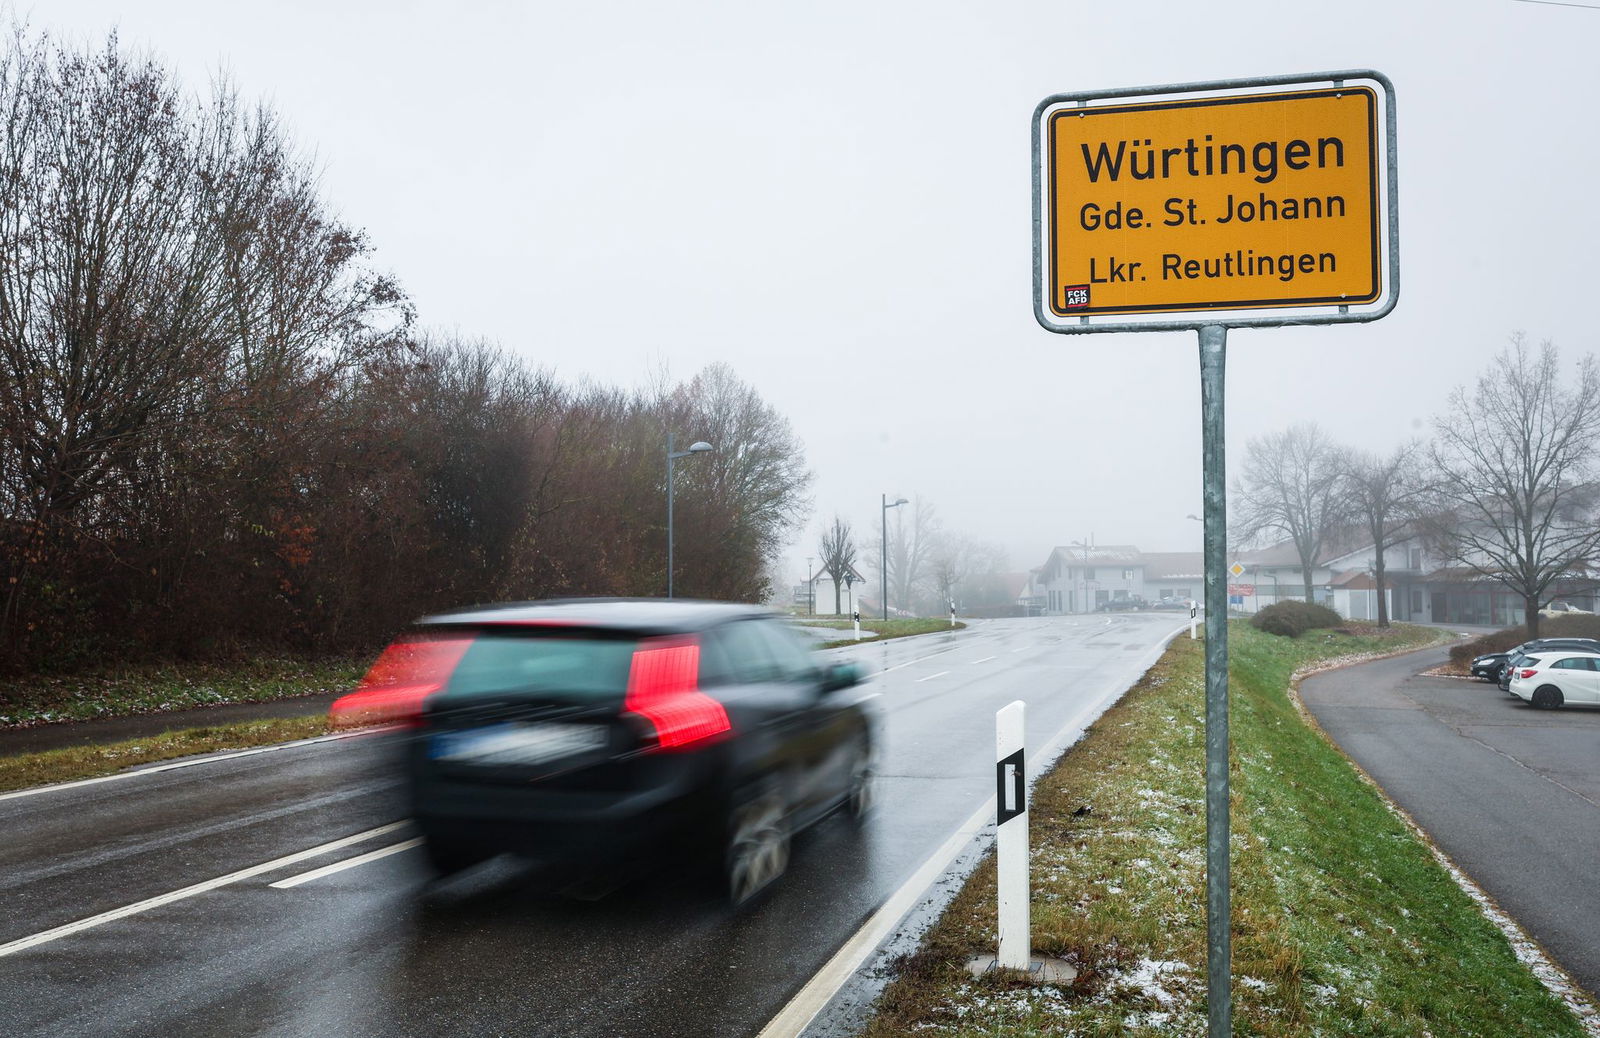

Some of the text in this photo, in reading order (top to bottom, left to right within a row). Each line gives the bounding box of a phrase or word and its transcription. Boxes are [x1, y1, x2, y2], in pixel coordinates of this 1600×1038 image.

[1081, 135, 1343, 184] Würtingen
[1080, 193, 1345, 232] Gde. St. Johann
[1091, 250, 1336, 284] Lkr. Reutlingen
[1067, 290, 1087, 298] FCK
[1068, 297, 1087, 305] AFD
